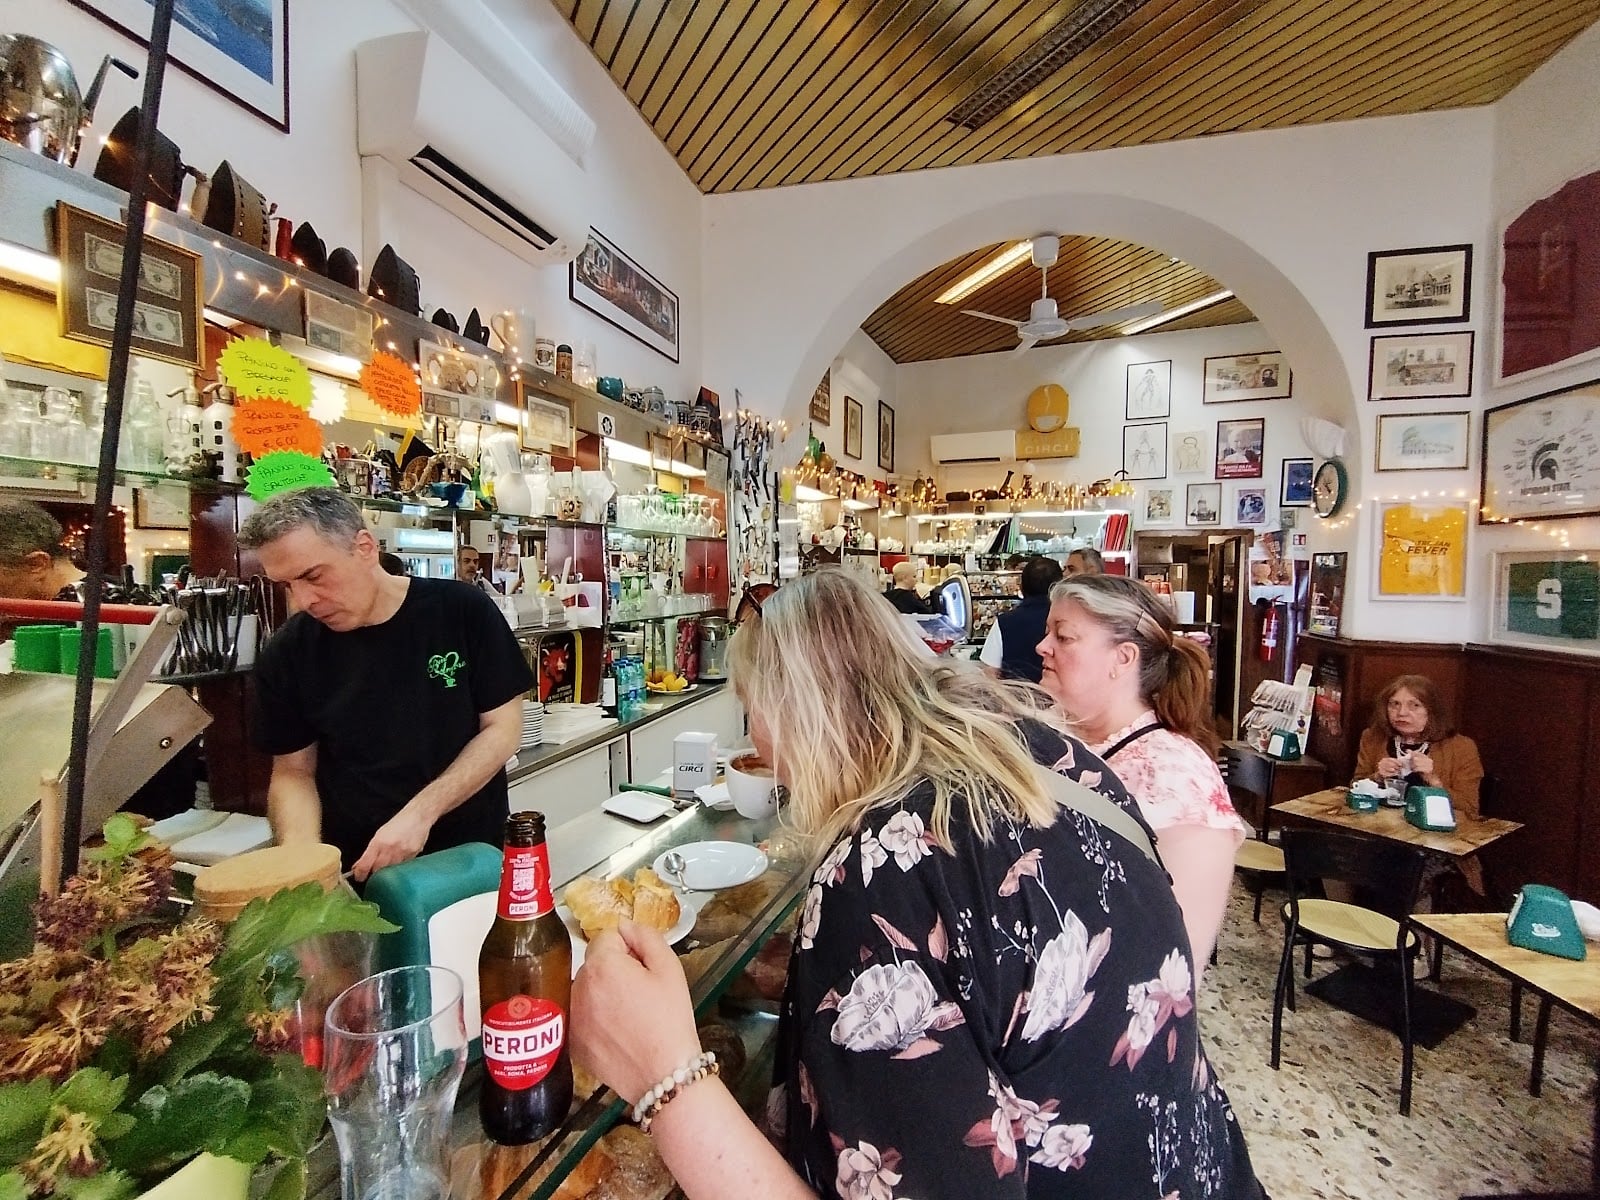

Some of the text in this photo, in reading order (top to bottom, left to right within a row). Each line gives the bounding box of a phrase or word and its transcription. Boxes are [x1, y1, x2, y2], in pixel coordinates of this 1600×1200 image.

[1407, 546, 1448, 556] FEVER
[1537, 579, 1561, 619] S
[484, 1023, 559, 1054] PERONI
